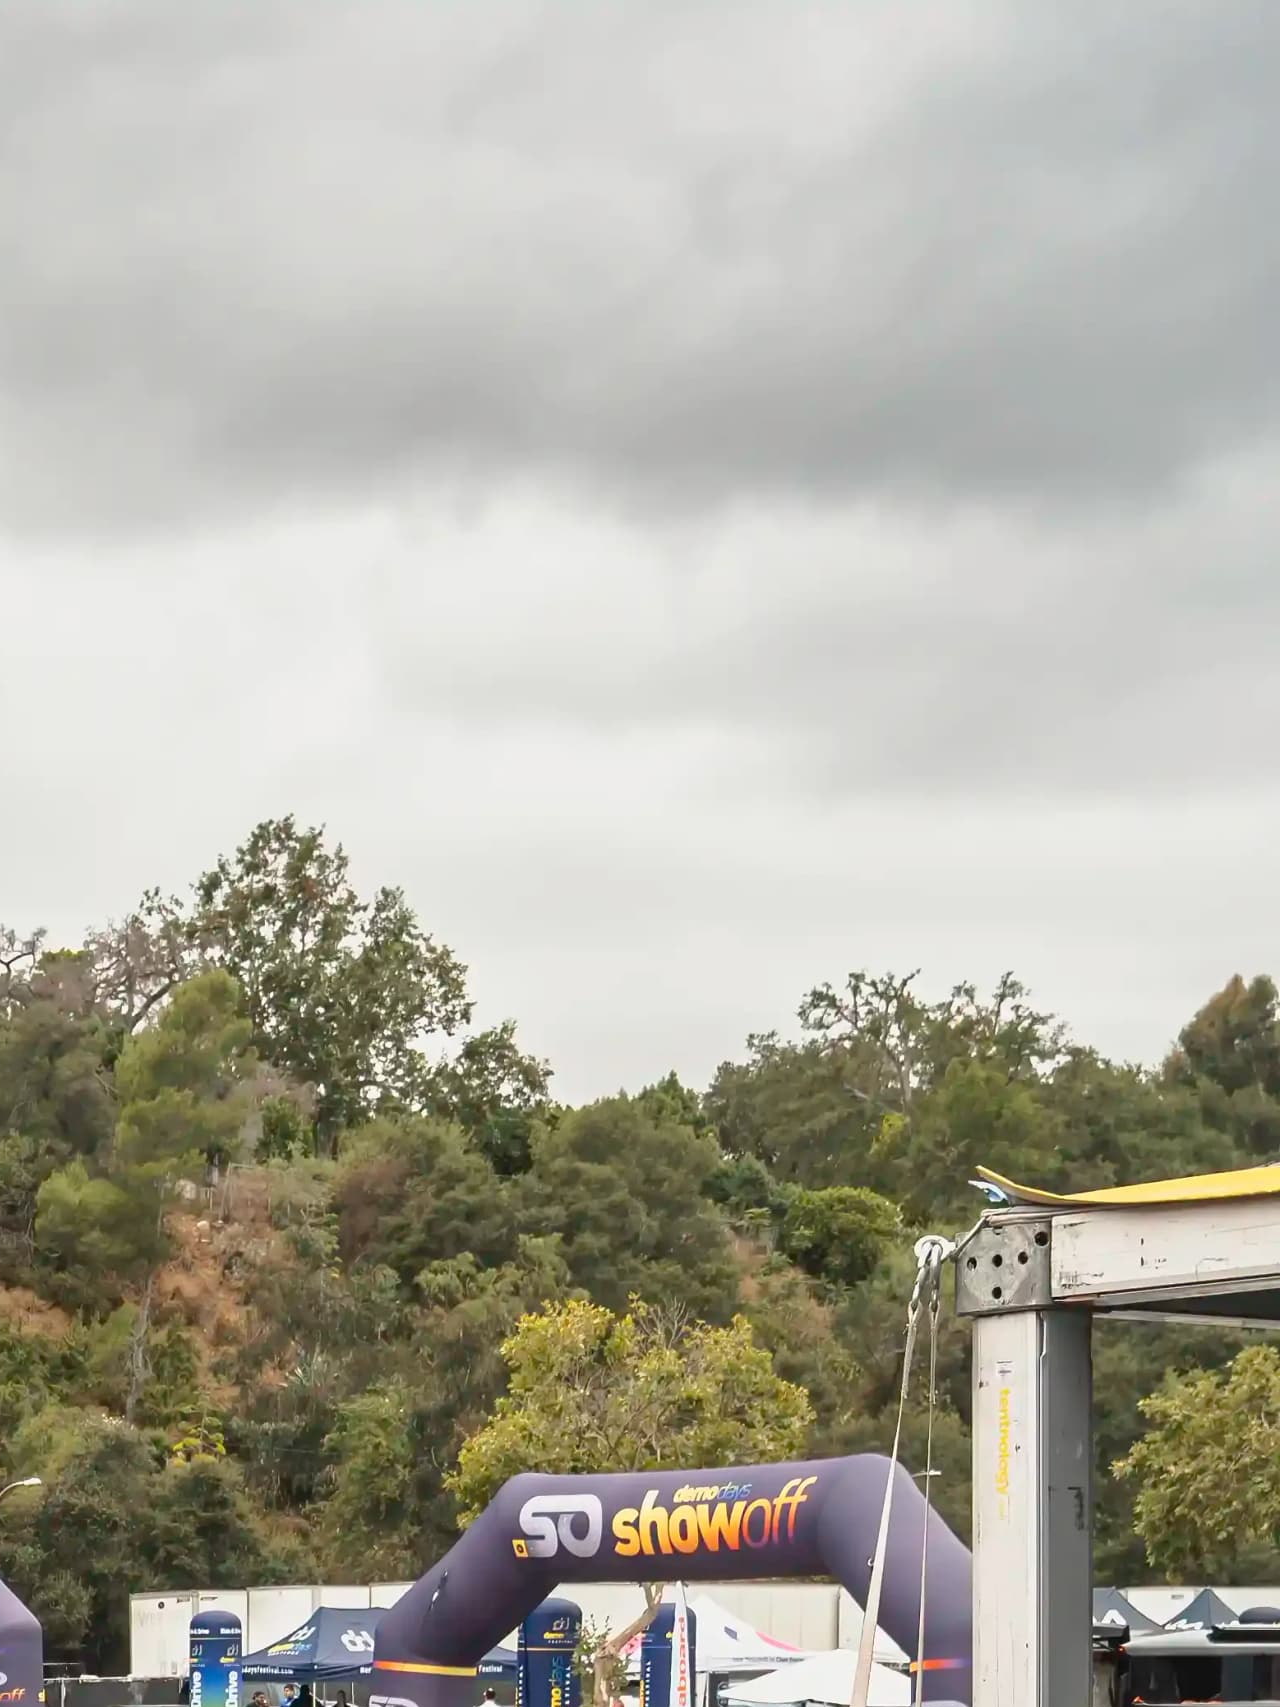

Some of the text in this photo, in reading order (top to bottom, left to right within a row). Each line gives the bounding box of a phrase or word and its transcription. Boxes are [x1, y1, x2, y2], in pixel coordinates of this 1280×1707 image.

[672, 1481, 753, 1503] demodays
[611, 1475, 819, 1557] showoff
[241, 1667, 295, 1677] daysfestival.com
